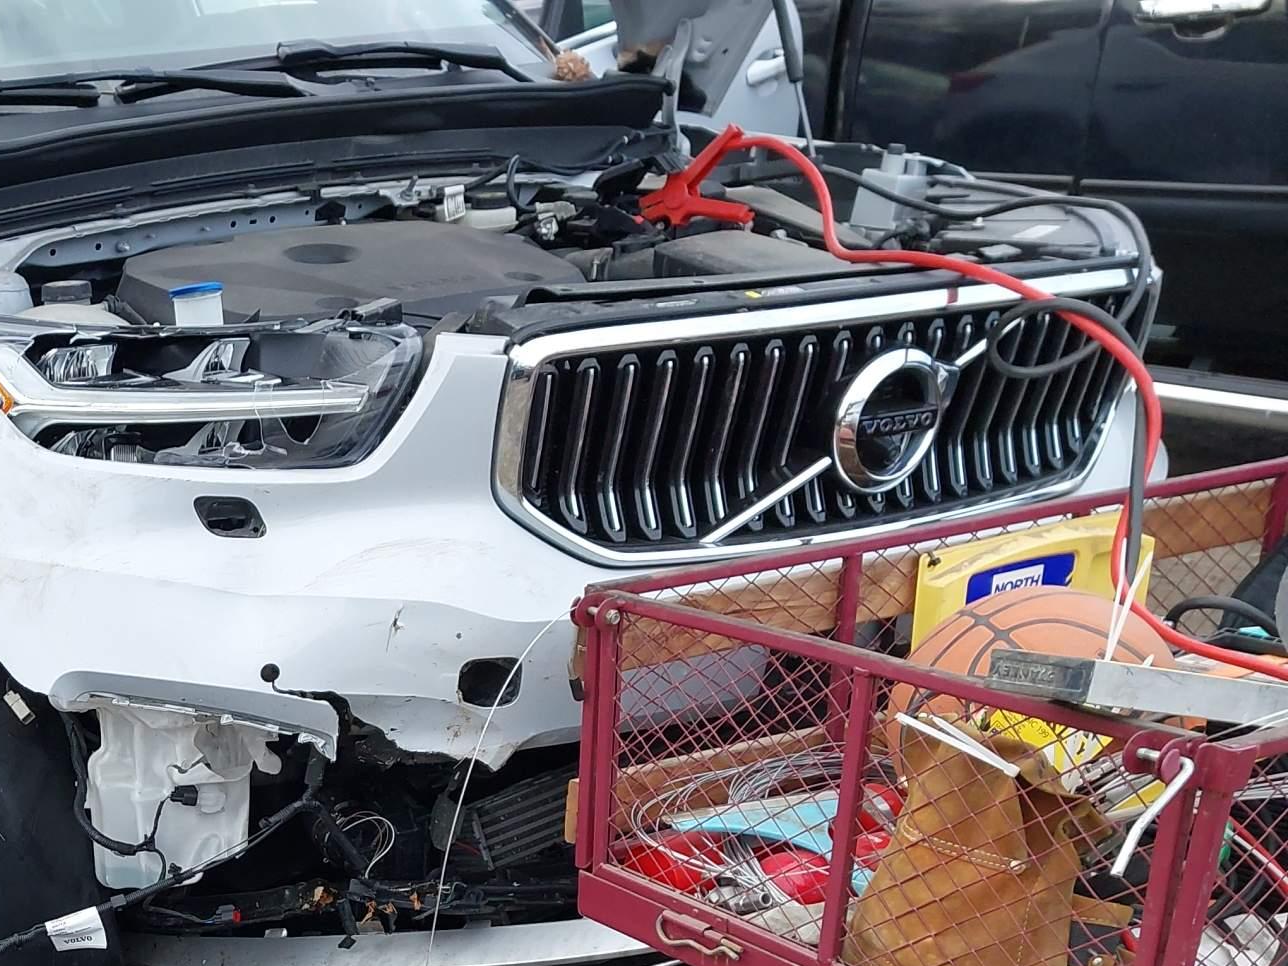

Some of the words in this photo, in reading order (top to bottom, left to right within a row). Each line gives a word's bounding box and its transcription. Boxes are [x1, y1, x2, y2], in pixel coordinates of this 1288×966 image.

[862, 412, 933, 434] VOLVO
[994, 574, 1041, 593] NORTH
[63, 935, 93, 944] VOLVO
